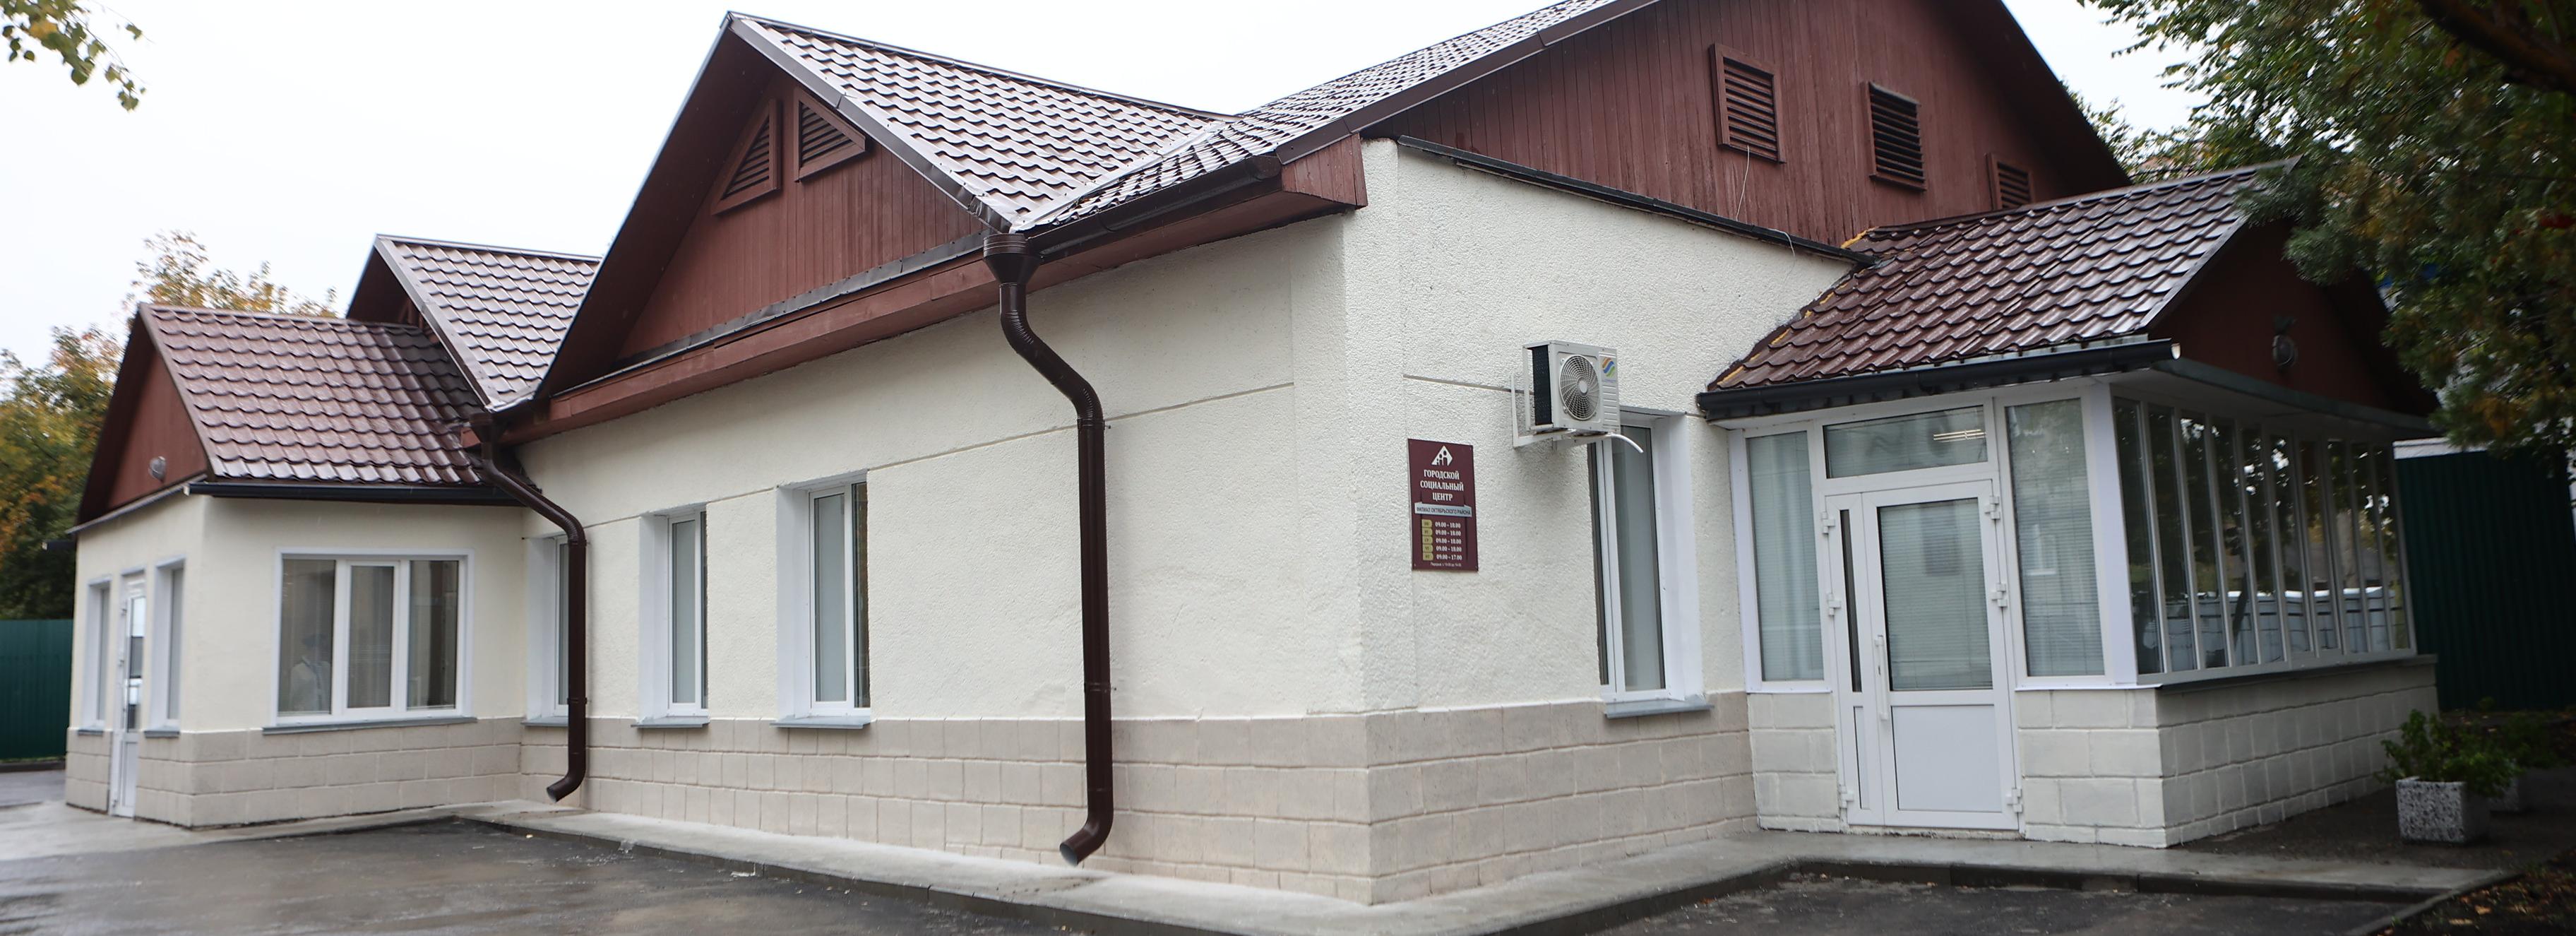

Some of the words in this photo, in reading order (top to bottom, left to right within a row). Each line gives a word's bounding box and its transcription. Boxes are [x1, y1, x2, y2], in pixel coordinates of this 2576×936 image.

[1424, 469, 1460, 480] ГОРОДСКОЙ
[1420, 480, 1464, 491] СОЦИАЛЬНЫЙ
[1432, 492, 1453, 502] ЦЕНТР
